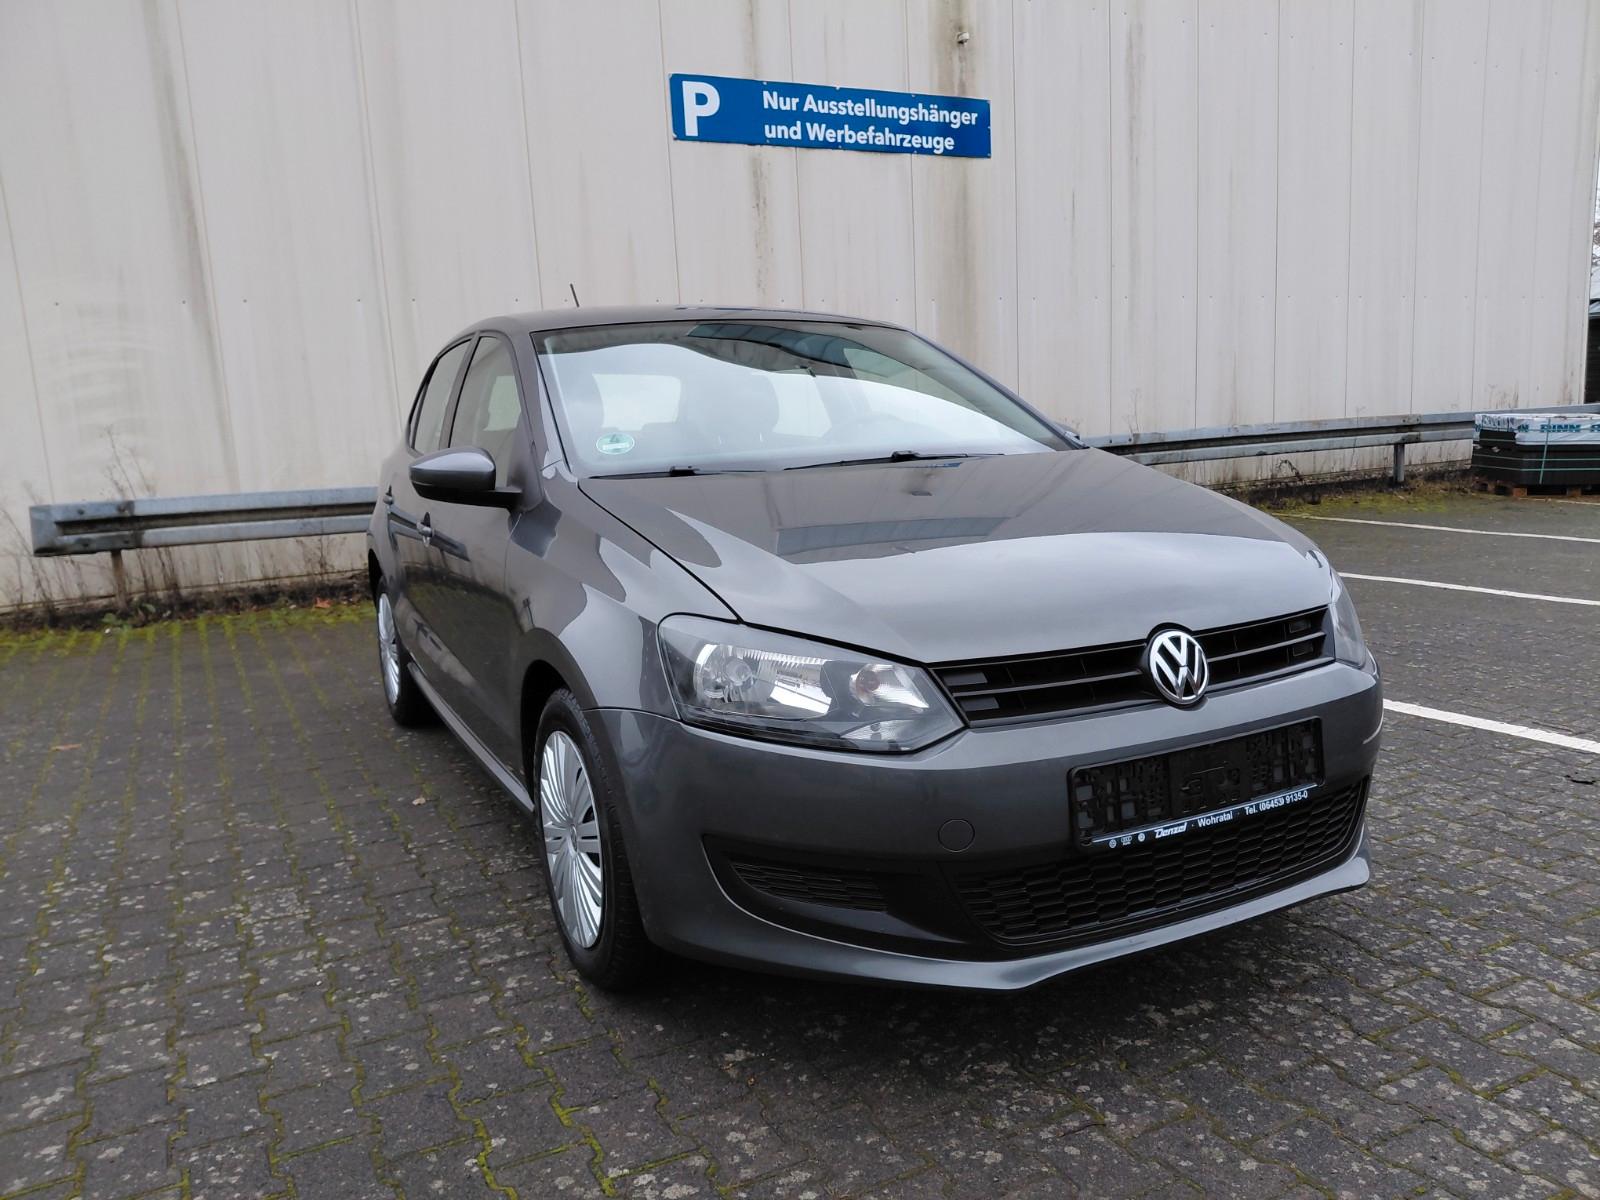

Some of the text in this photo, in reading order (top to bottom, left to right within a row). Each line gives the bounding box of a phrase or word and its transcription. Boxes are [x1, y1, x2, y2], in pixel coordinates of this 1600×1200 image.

[681, 80, 721, 137] P
[762, 90, 978, 128] Nur Ausstellungshänger
[764, 121, 955, 154] und Werbefahrzeuge
[1197, 810, 1233, 828] Wohratal
[1244, 805, 1258, 816] Tel.
[1285, 790, 1308, 804] 9135-0
